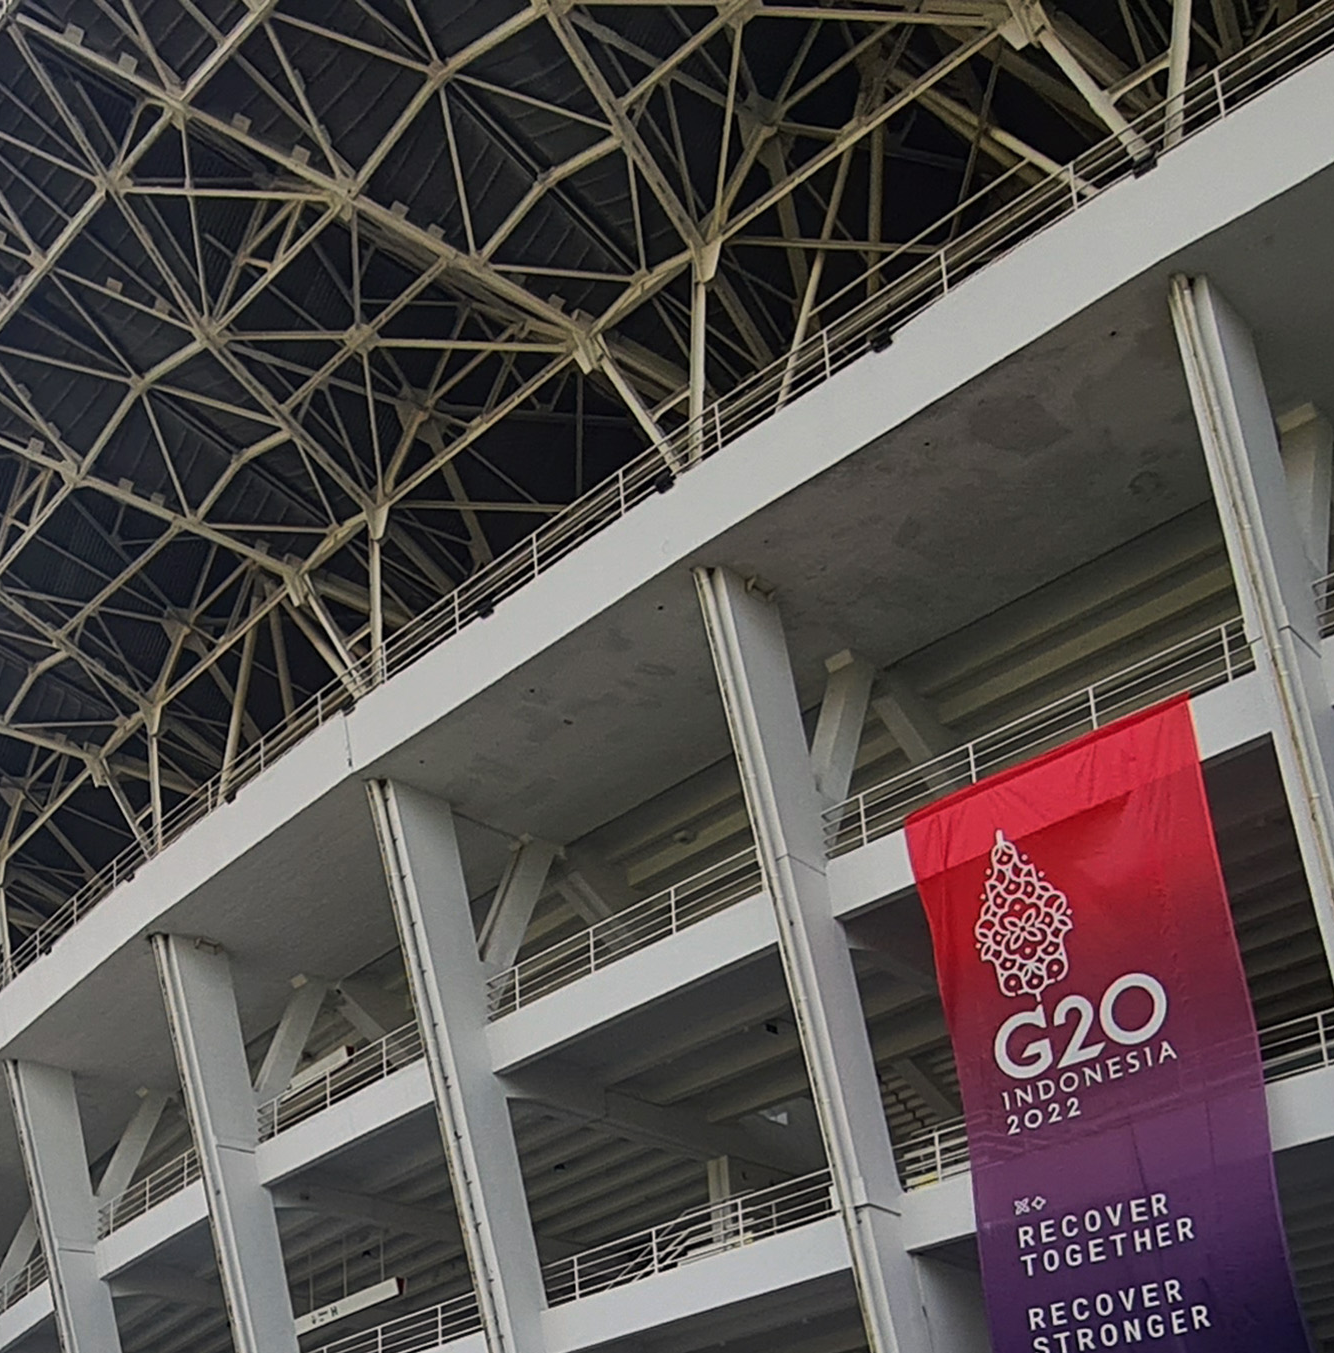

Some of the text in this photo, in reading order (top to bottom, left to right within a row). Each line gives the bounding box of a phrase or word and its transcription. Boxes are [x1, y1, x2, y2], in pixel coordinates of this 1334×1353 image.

[994, 972, 1168, 1080] G20
[1001, 1040, 1178, 1112] INDONESIA
[1006, 1096, 1082, 1136] 2022
[1018, 1192, 1169, 1249] RECOVER
[1020, 1216, 1196, 1277] TOGETHER
[1028, 1278, 1184, 1332] RECOVER
